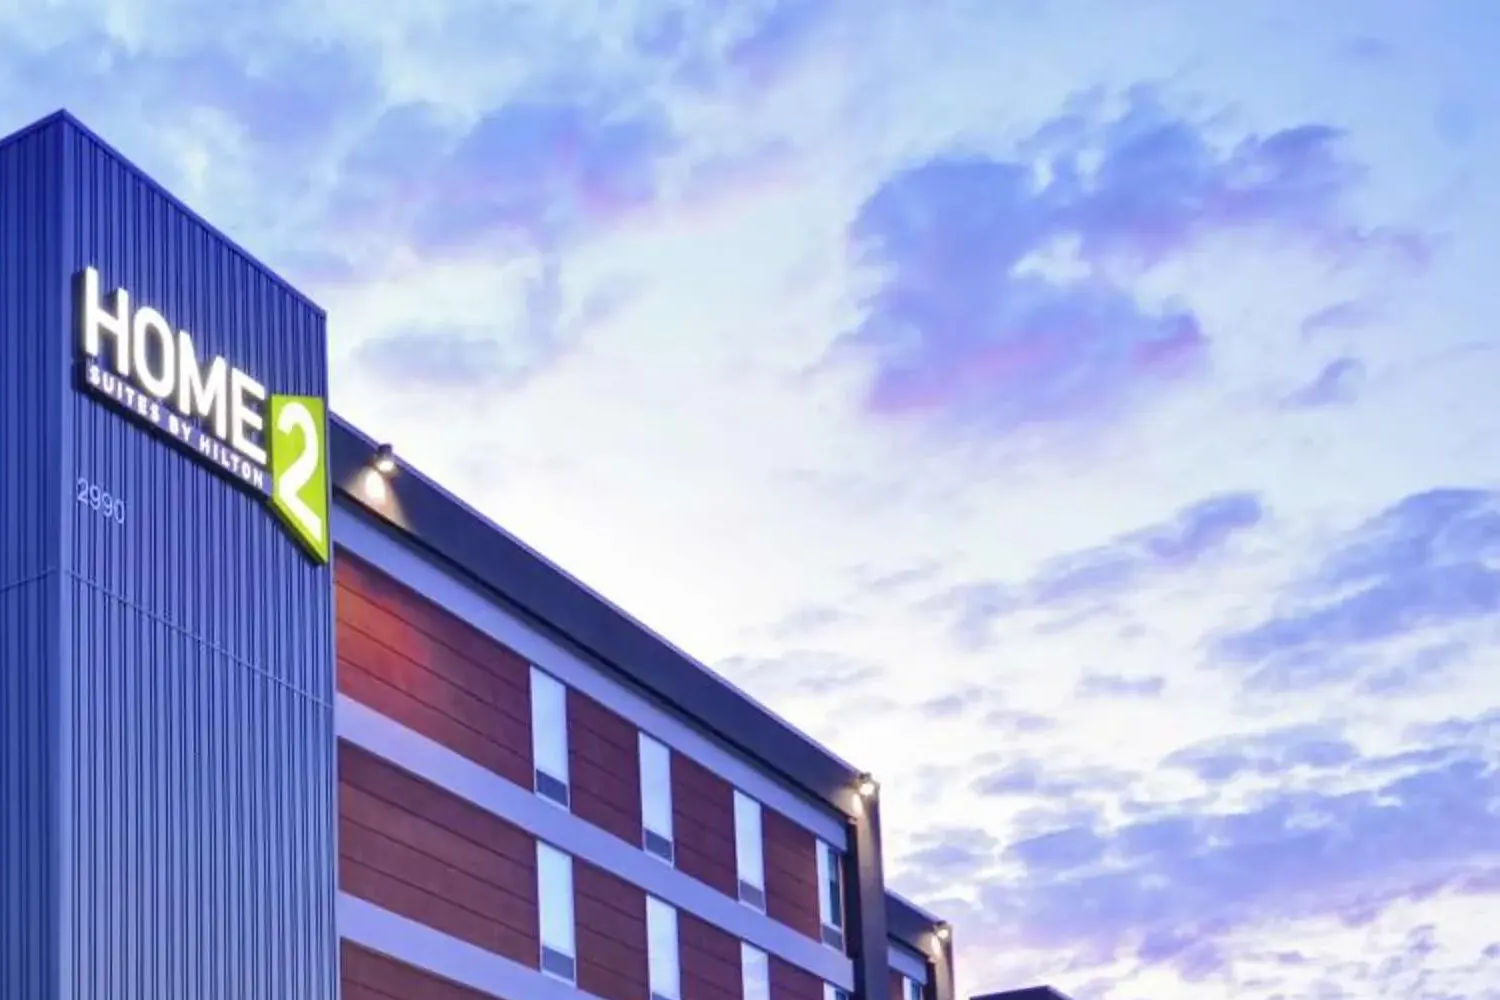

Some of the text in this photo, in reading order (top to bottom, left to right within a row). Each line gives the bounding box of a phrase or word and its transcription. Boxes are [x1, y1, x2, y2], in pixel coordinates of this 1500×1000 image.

[84, 265, 323, 544] HOME 2
[88, 364, 264, 490] SUITES BY HILTON
[76, 477, 126, 524] 2990
